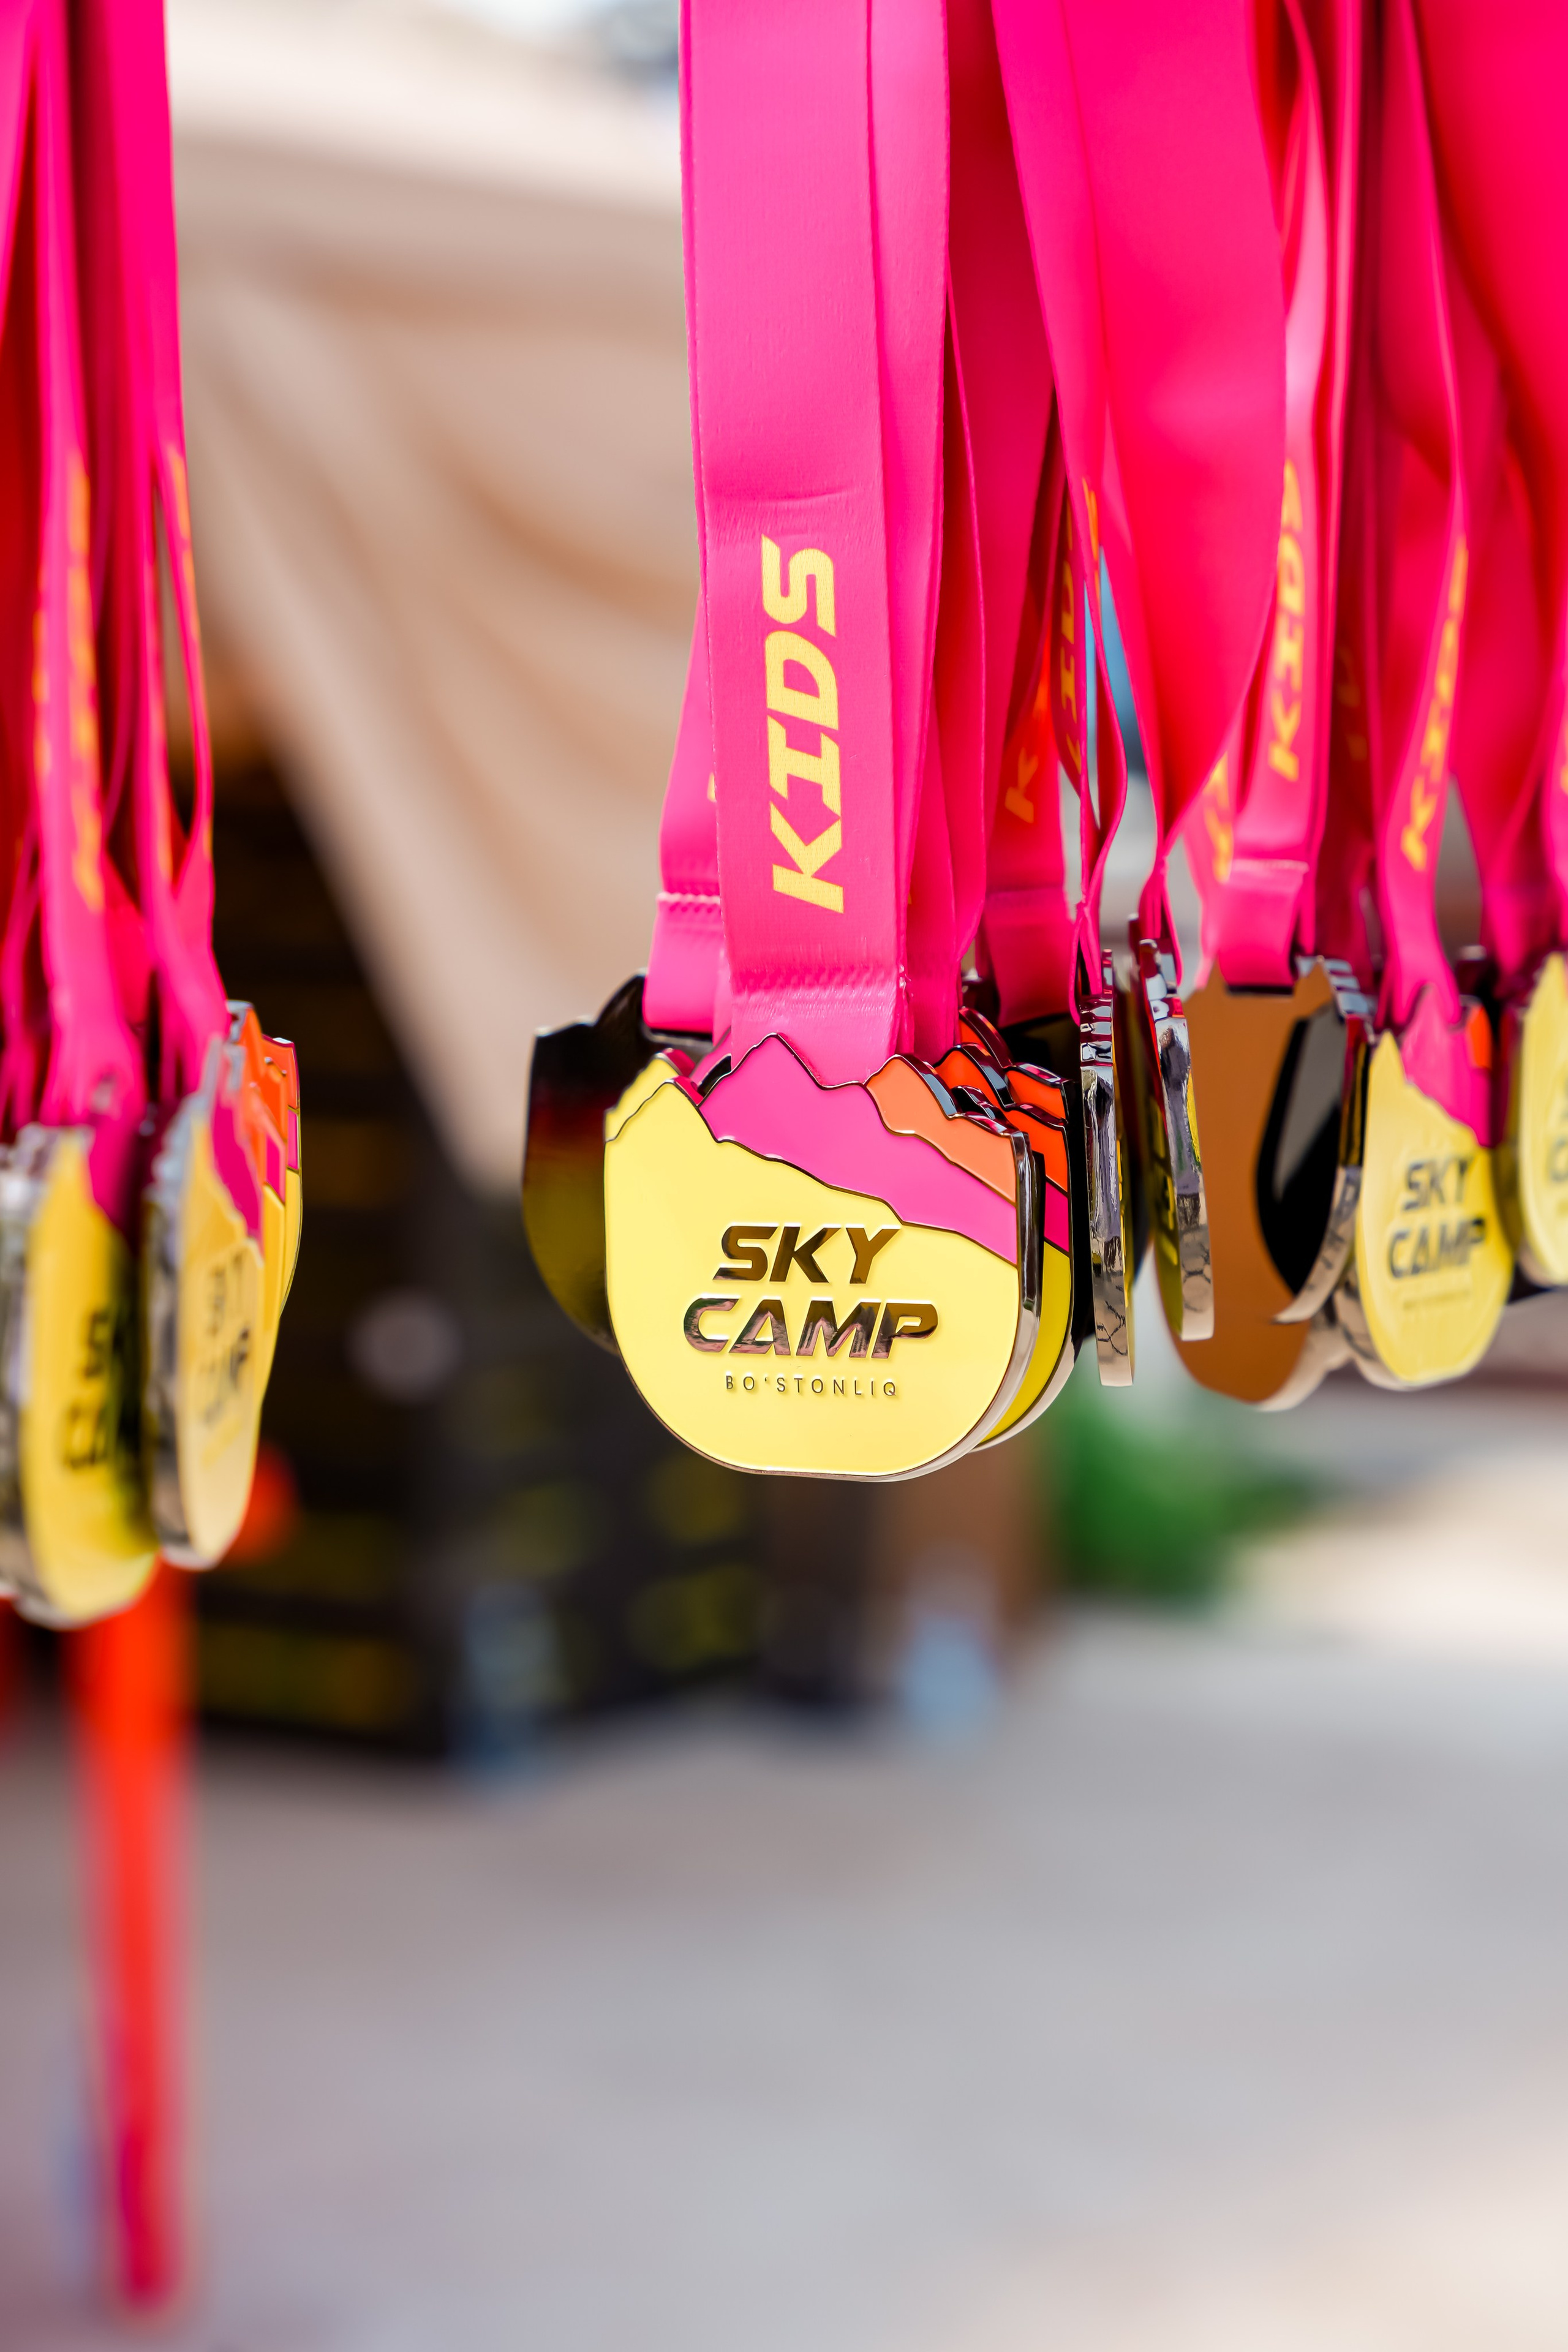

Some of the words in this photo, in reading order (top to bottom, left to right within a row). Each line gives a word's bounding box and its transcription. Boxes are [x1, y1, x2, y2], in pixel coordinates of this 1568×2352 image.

[761, 533, 845, 914] KIDS
[1403, 1155, 1475, 1213] SKY
[712, 1223, 901, 1284] SKY
[1389, 1216, 1487, 1279] CAMP
[683, 1295, 939, 1359] CAMP
